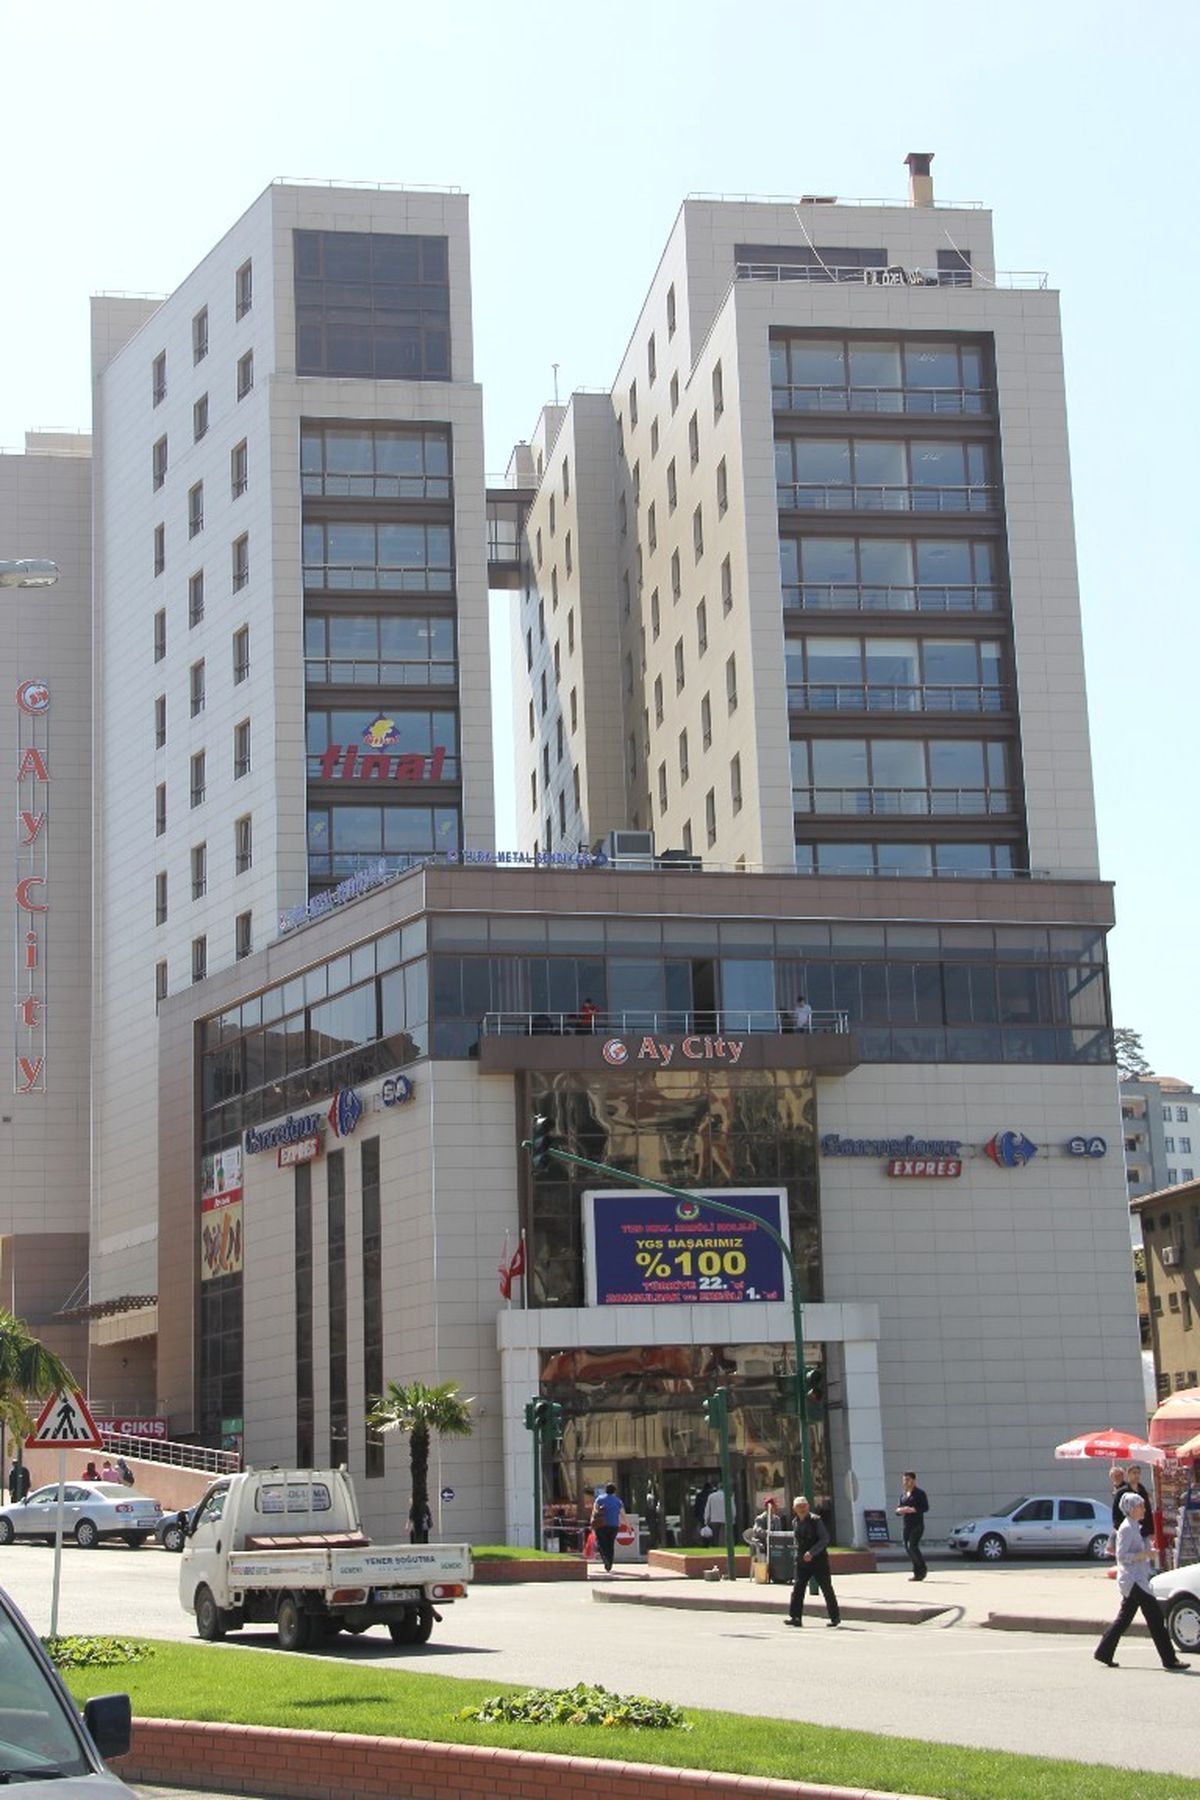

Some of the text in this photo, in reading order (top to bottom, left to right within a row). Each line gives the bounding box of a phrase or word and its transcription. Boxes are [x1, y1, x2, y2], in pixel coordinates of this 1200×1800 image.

[320, 744, 446, 781] final
[497, 851, 531, 863] METAL
[637, 1035, 744, 1067] Ay City
[1069, 1138, 1106, 1156] SA
[893, 1161, 957, 1176] EXPRES
[635, 1238, 744, 1250] YGS BAŞARIMIZ
[635, 1250, 747, 1278] %100
[699, 1276, 728, 1290] 22.
[746, 1287, 761, 1300] 1.
